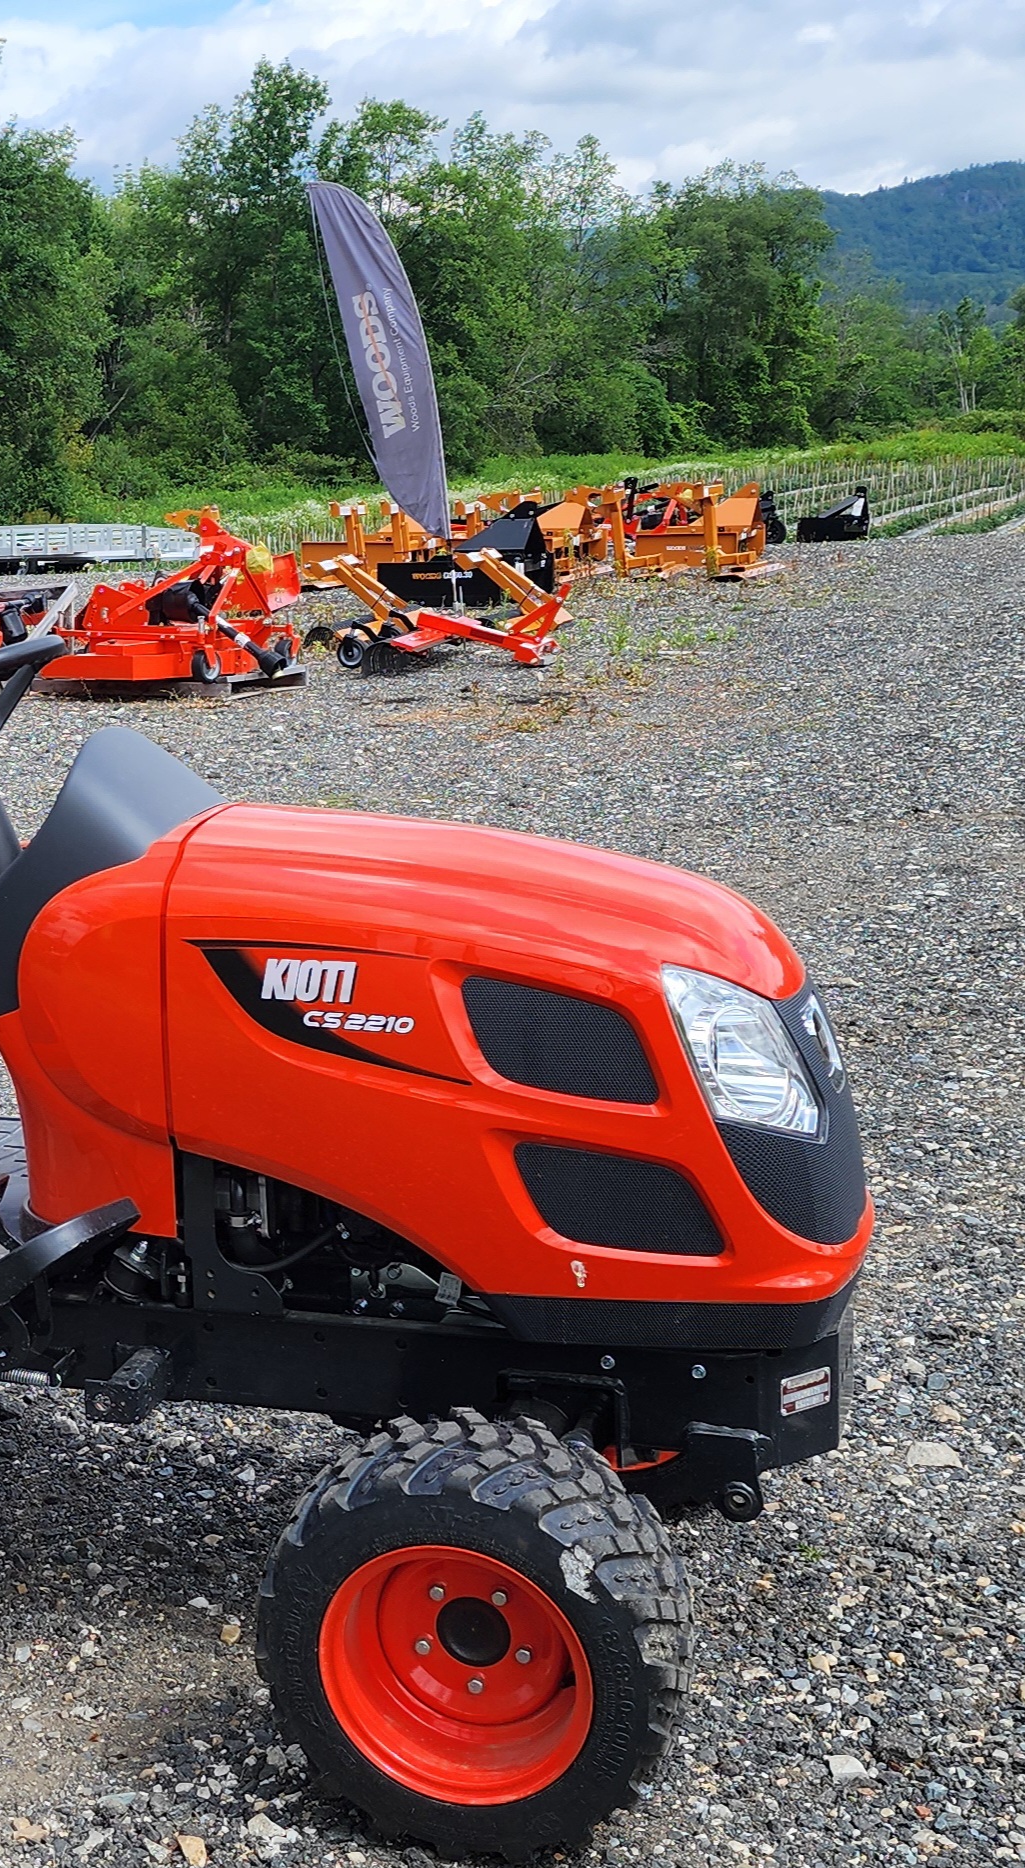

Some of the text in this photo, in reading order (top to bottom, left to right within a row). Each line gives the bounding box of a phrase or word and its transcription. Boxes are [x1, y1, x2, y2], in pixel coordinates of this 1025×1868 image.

[352, 291, 406, 438] WOODS
[382, 287, 420, 433] Woods Equipment Company
[261, 958, 358, 1003] KIOTI
